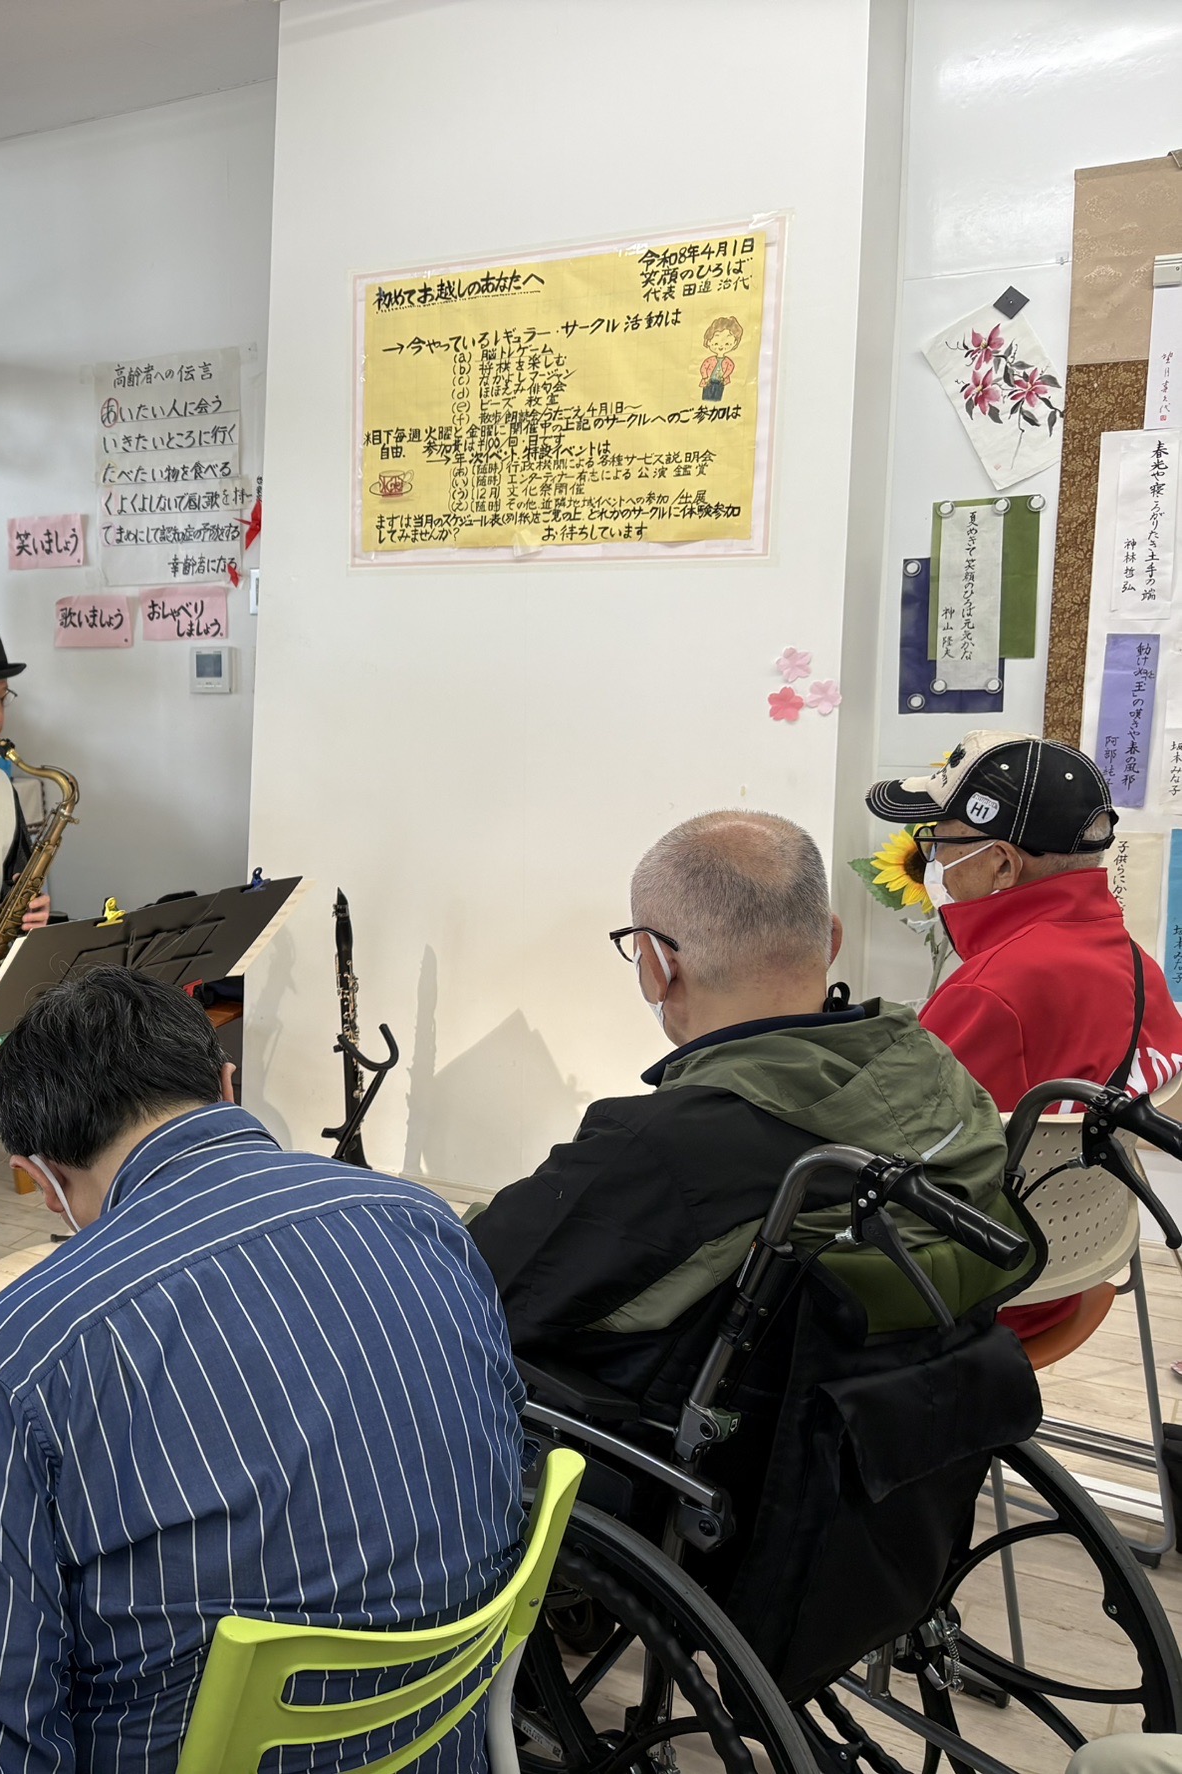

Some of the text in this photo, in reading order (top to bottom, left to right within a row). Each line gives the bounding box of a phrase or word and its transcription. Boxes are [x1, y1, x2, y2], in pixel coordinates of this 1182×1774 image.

[638, 237, 754, 271] 令和8年4月1日
[640, 257, 754, 288] 笑顔のひろば
[373, 269, 545, 311] 初めてお越しのあなたへ
[479, 353, 567, 375] 将棋を楽しむ
[480, 343, 555, 361] 脳トレゲーム
[113, 361, 213, 389] 高齢者への伝言
[479, 381, 567, 399] ほほえみ俳句会
[101, 395, 222, 425] あいたい人に会う
[103, 424, 236, 453] いきたいところに行く
[102, 460, 232, 484] たべたい物を食べる
[541, 521, 648, 541] お待ちしています
[147, 599, 205, 622] おしゃべり
[970, 801, 990, 820] H1
